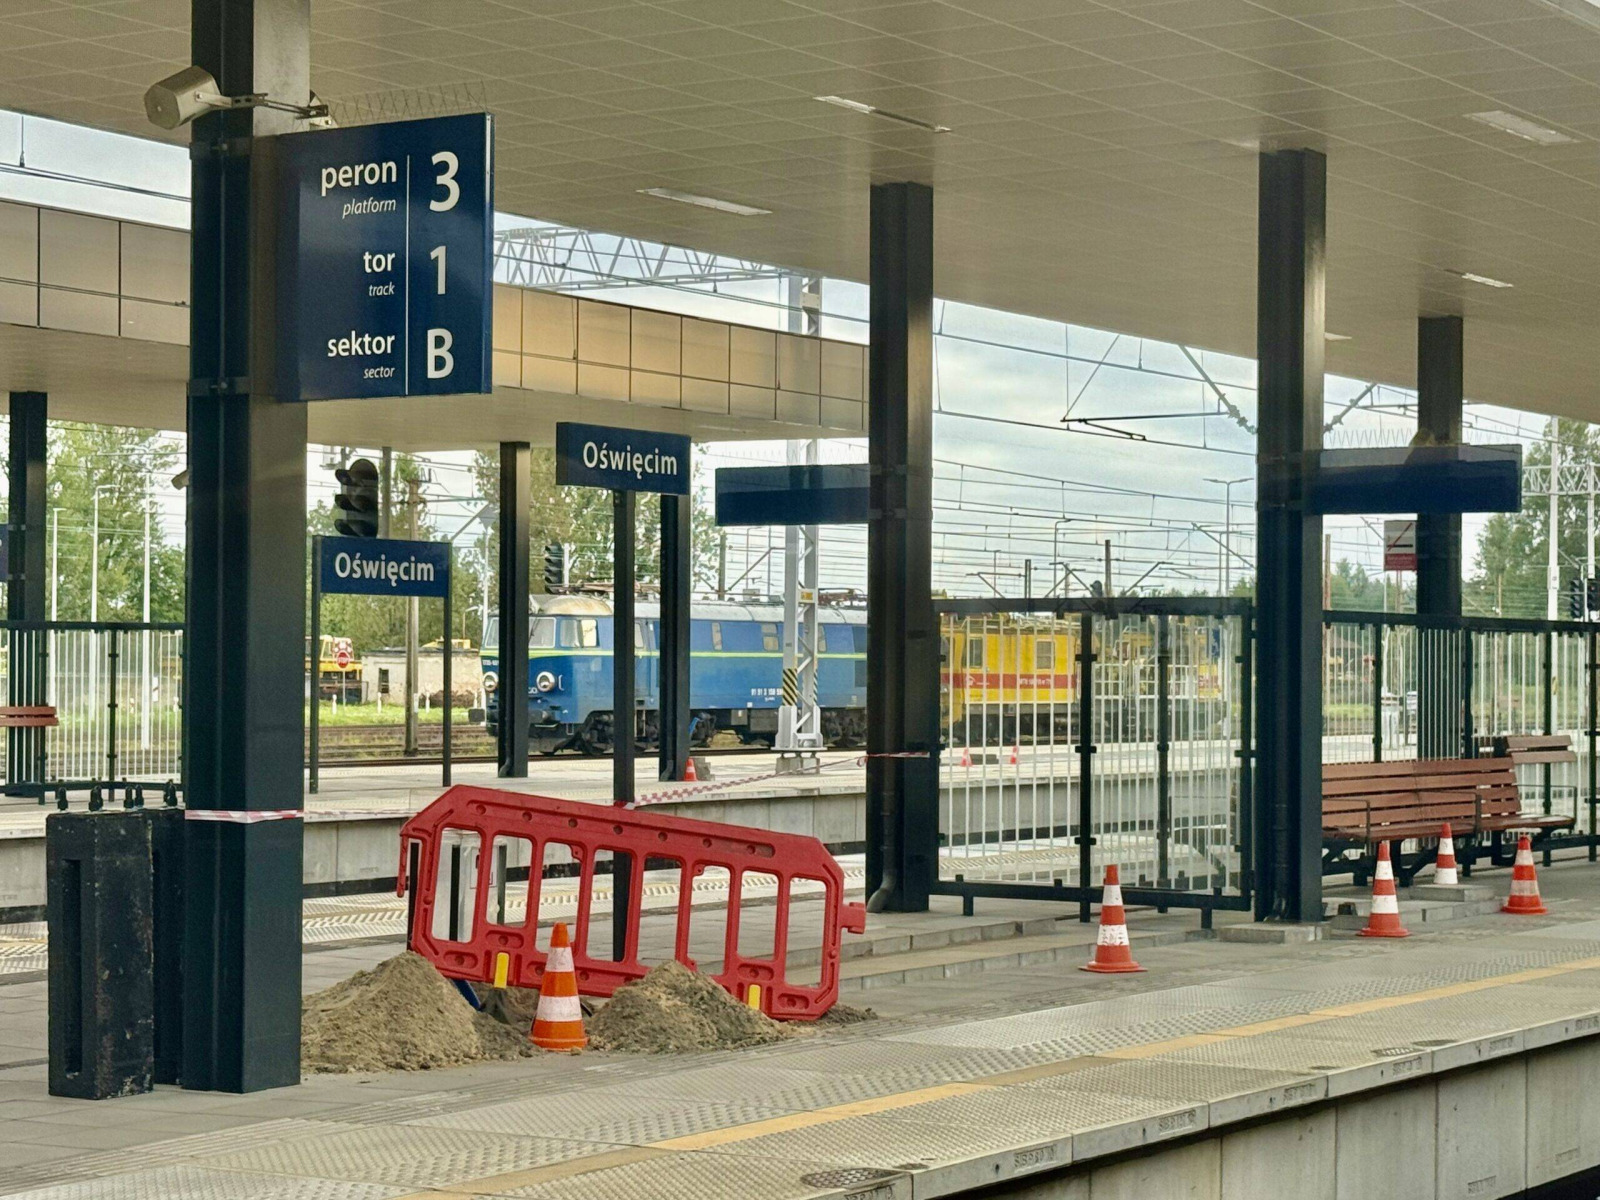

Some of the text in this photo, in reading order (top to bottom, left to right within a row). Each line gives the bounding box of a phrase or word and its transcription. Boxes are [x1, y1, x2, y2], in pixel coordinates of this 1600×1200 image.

[321, 151, 460, 212] peron 3
[342, 196, 396, 219] platform
[363, 245, 447, 295] tor 1
[368, 282, 395, 296] track
[327, 328, 454, 379] sektor B
[363, 366, 396, 379] sector
[583, 441, 678, 479] Oświęcim
[334, 552, 435, 586] Oświęcim
